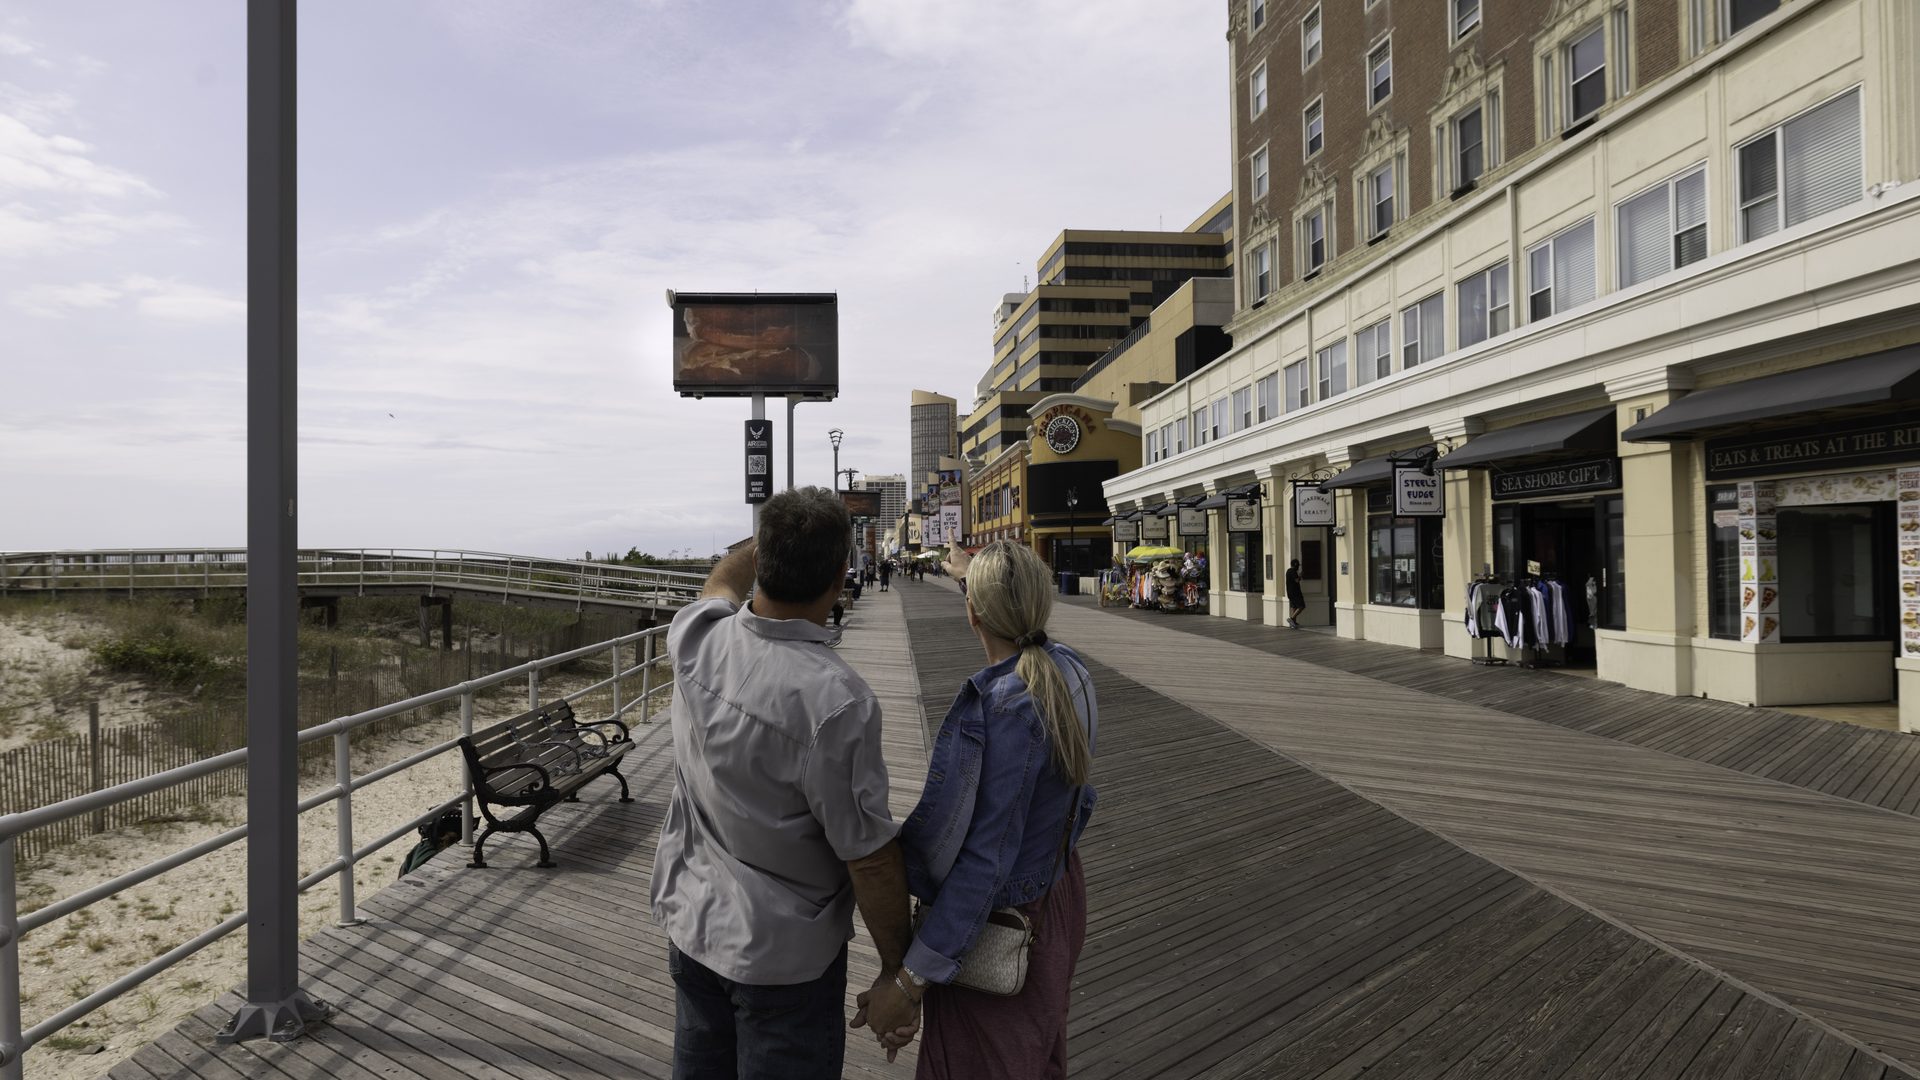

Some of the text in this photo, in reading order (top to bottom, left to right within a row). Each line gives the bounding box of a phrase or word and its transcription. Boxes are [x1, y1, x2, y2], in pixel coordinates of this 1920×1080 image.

[1715, 427, 1920, 466] EATS & TREATS AT THE RIT
[1404, 478, 1437, 488] STEEL'S
[1502, 465, 1601, 491] SEA SHORE GIFT
[1407, 490, 1434, 499] FUDGE
[1301, 495, 1331, 506] BOARDWALK
